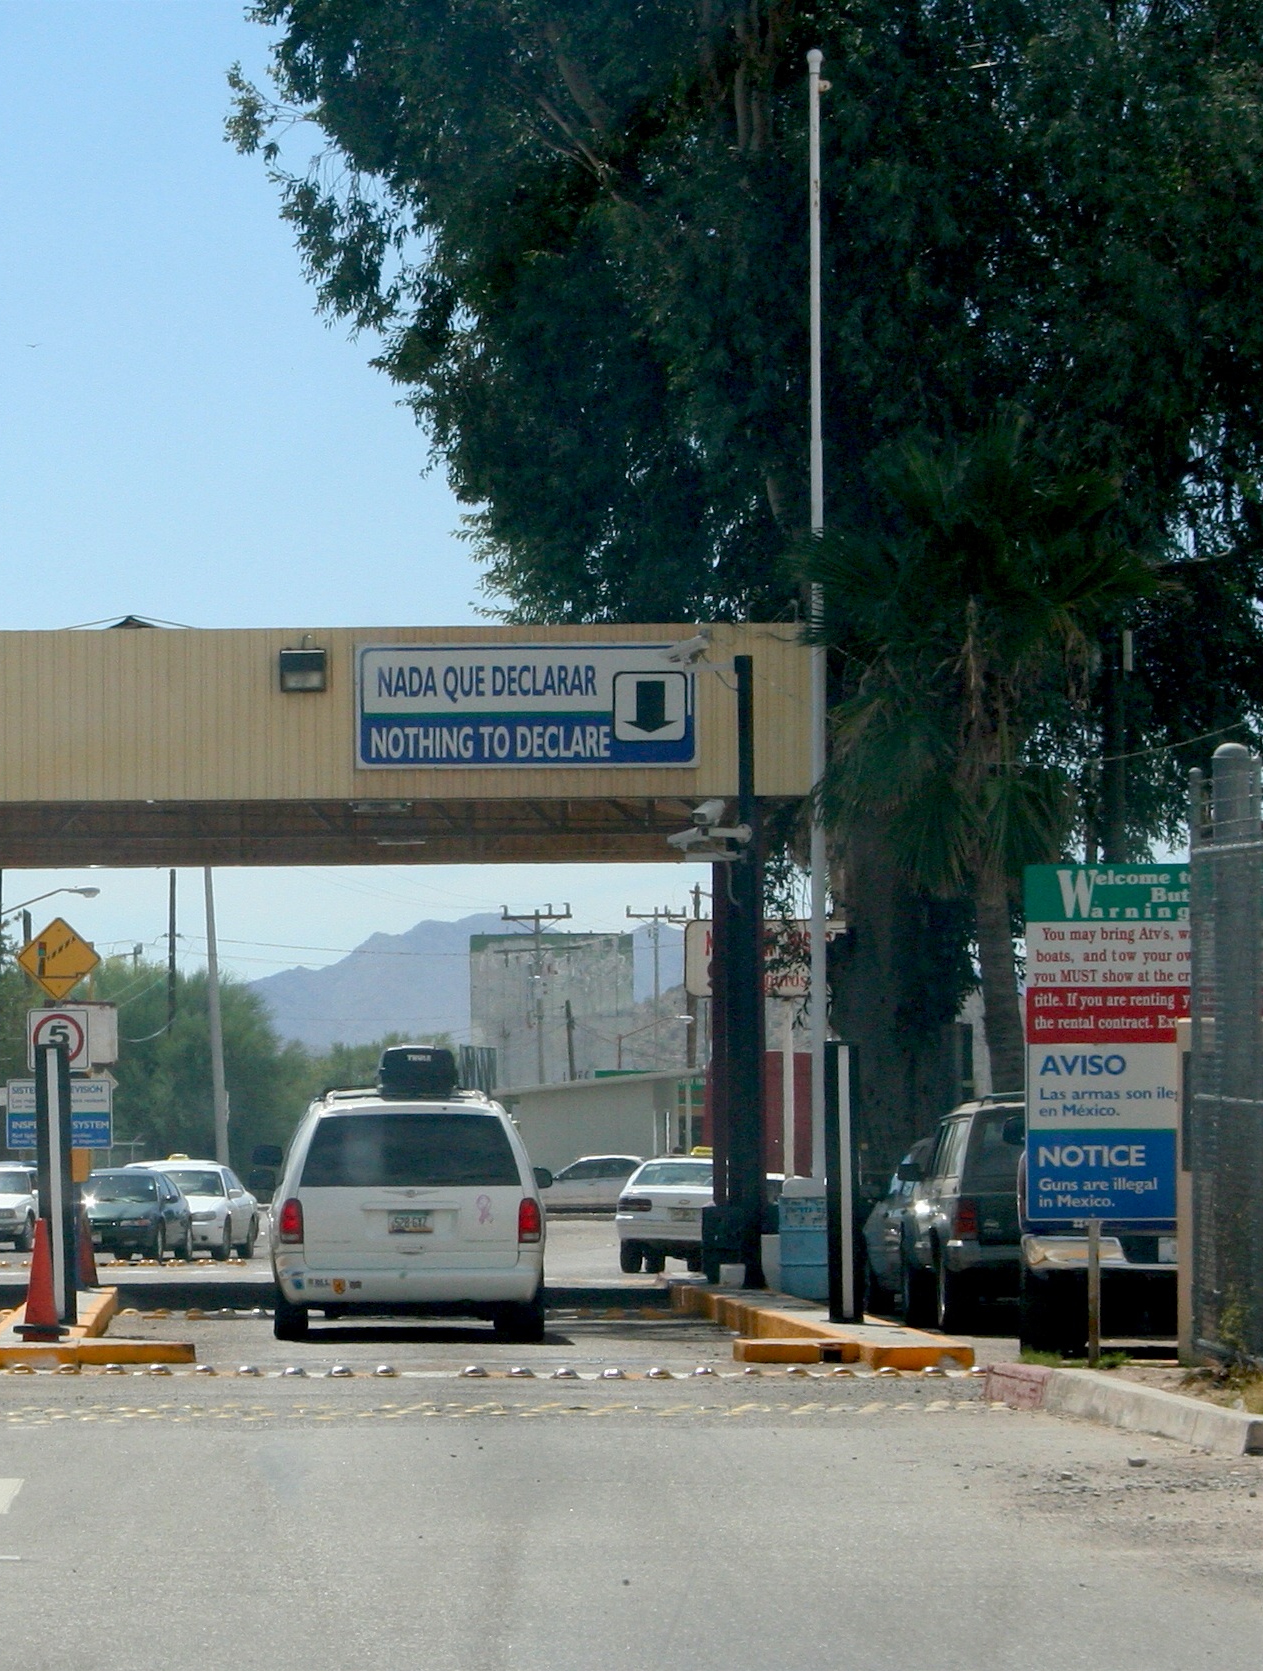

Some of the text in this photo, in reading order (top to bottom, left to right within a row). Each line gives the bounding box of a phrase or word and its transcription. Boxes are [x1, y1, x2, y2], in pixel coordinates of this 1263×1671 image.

[377, 664, 597, 703] NADA QUE DECLARAR
[370, 725, 611, 759] NOTHING TO DECLARE
[1042, 927, 1065, 941] You
[1069, 930, 1097, 944] may
[1100, 927, 1135, 944] bring
[1036, 949, 1075, 963] boats,
[1083, 949, 1107, 962] and
[1142, 951, 1173, 965] your
[1034, 972, 1056, 986] you
[1060, 969, 1098, 983] MUST
[1102, 969, 1133, 982] show
[1137, 971, 1149, 982] at
[1154, 969, 1174, 982] the
[1067, 992, 1078, 1007] If
[1079, 995, 1103, 1010] you
[1106, 995, 1127, 1007] are
[1130, 993, 1175, 1010] renting
[1034, 1016, 1055, 1030] the
[1057, 1016, 1094, 1029] rental
[1098, 1016, 1153, 1029] contract.
[49, 1025, 69, 1045] 5
[1039, 1054, 1126, 1076] AVISO
[1039, 1087, 1066, 1100] Las
[1071, 1090, 1120, 1100] armas
[1126, 1089, 1152, 1100] son
[1039, 1107, 1057, 1117] en
[72, 1121, 109, 1129] SYSTEM
[1038, 1145, 1146, 1168] NOTICE
[1038, 1177, 1158, 1195] Guns are illegal
[1039, 1195, 1053, 1208] in
